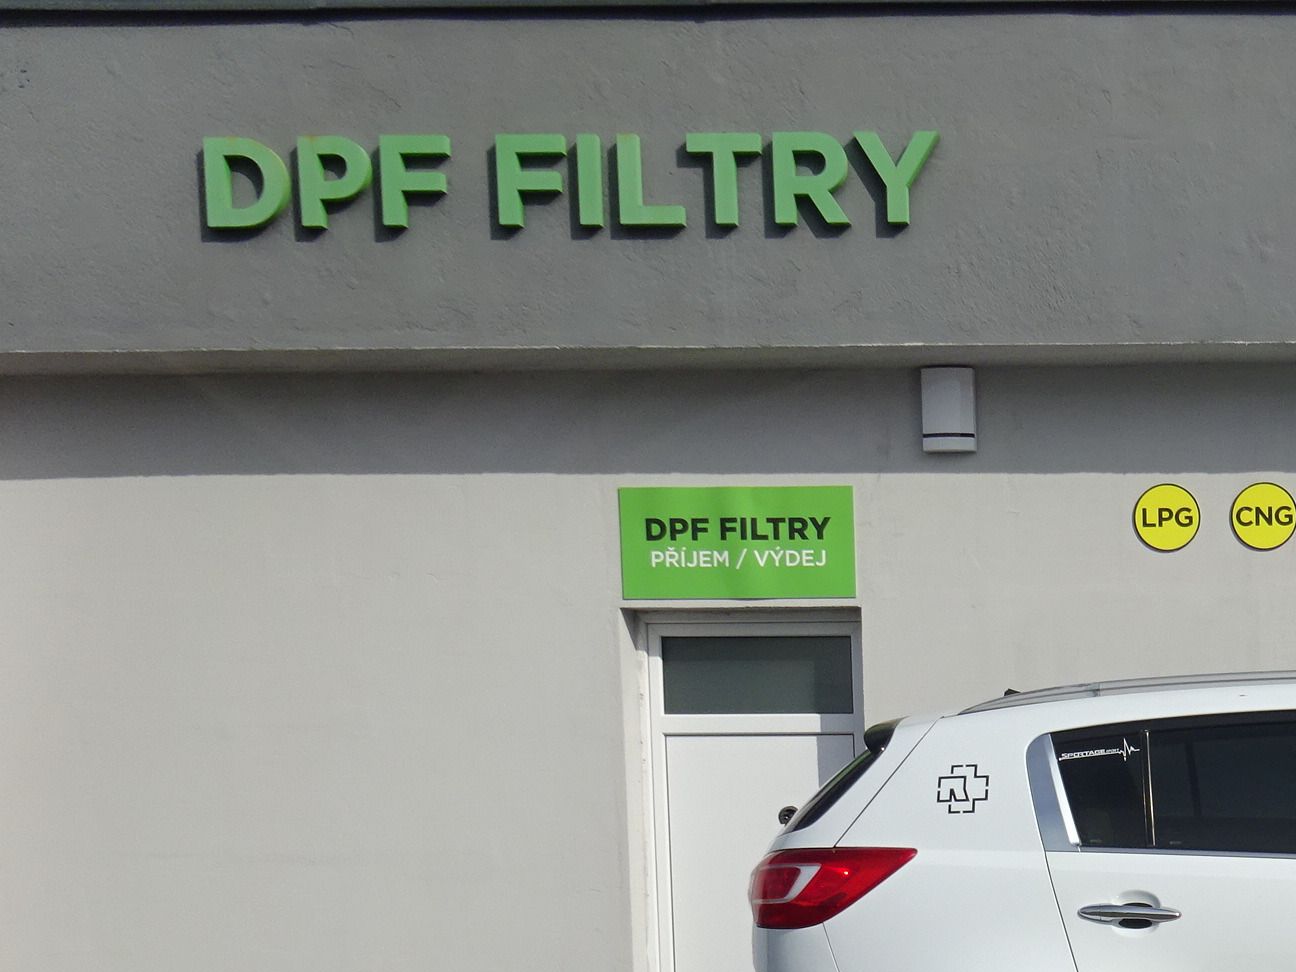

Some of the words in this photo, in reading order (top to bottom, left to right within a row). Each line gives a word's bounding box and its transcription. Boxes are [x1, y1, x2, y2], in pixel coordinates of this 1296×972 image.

[202, 133, 452, 230] DPF
[494, 130, 940, 230] FILTRY
[1142, 507, 1194, 527] LPG
[1236, 506, 1293, 527] CNG
[645, 518, 709, 541] DPF
[720, 517, 831, 540] FILTRY
[651, 547, 729, 567] PŘÍJEM
[754, 546, 826, 566] VÝDEJ
